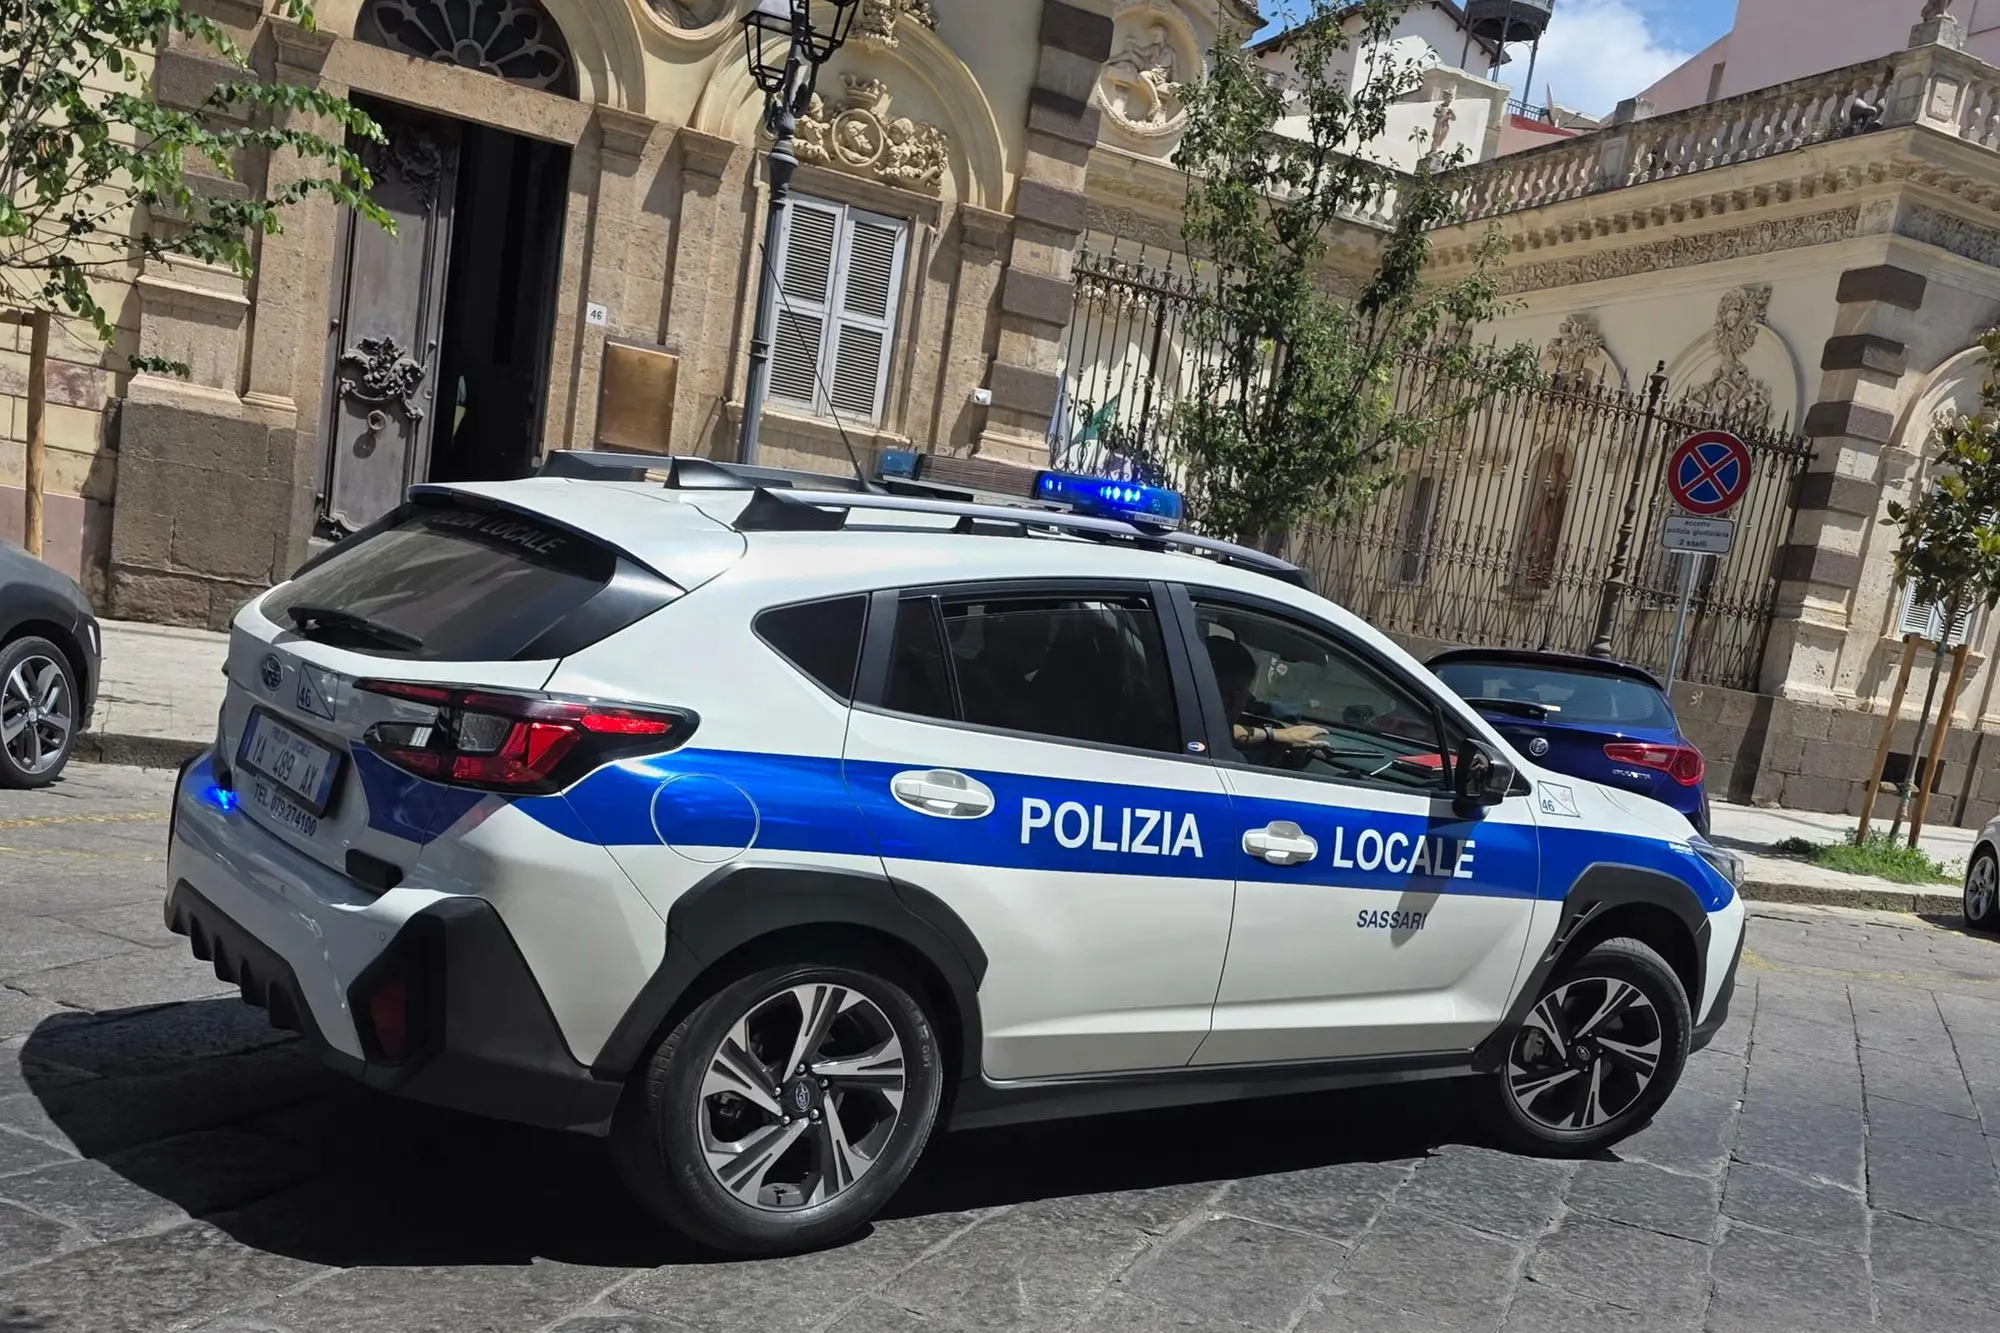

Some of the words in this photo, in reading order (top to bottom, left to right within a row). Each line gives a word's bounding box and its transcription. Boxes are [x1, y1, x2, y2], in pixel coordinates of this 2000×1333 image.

[590, 309, 603, 320] 46
[479, 515, 567, 554] LOCALE
[1679, 538, 1685, 546] 2
[299, 686, 311, 708] 46
[252, 734, 267, 765] YA
[272, 748, 295, 782] 489
[299, 764, 319, 797] AX
[1541, 799, 1555, 812] 46
[1020, 797, 1204, 858] POLIZIA
[1332, 826, 1476, 879] LOCALE
[1356, 910, 1427, 931] SASSARI
